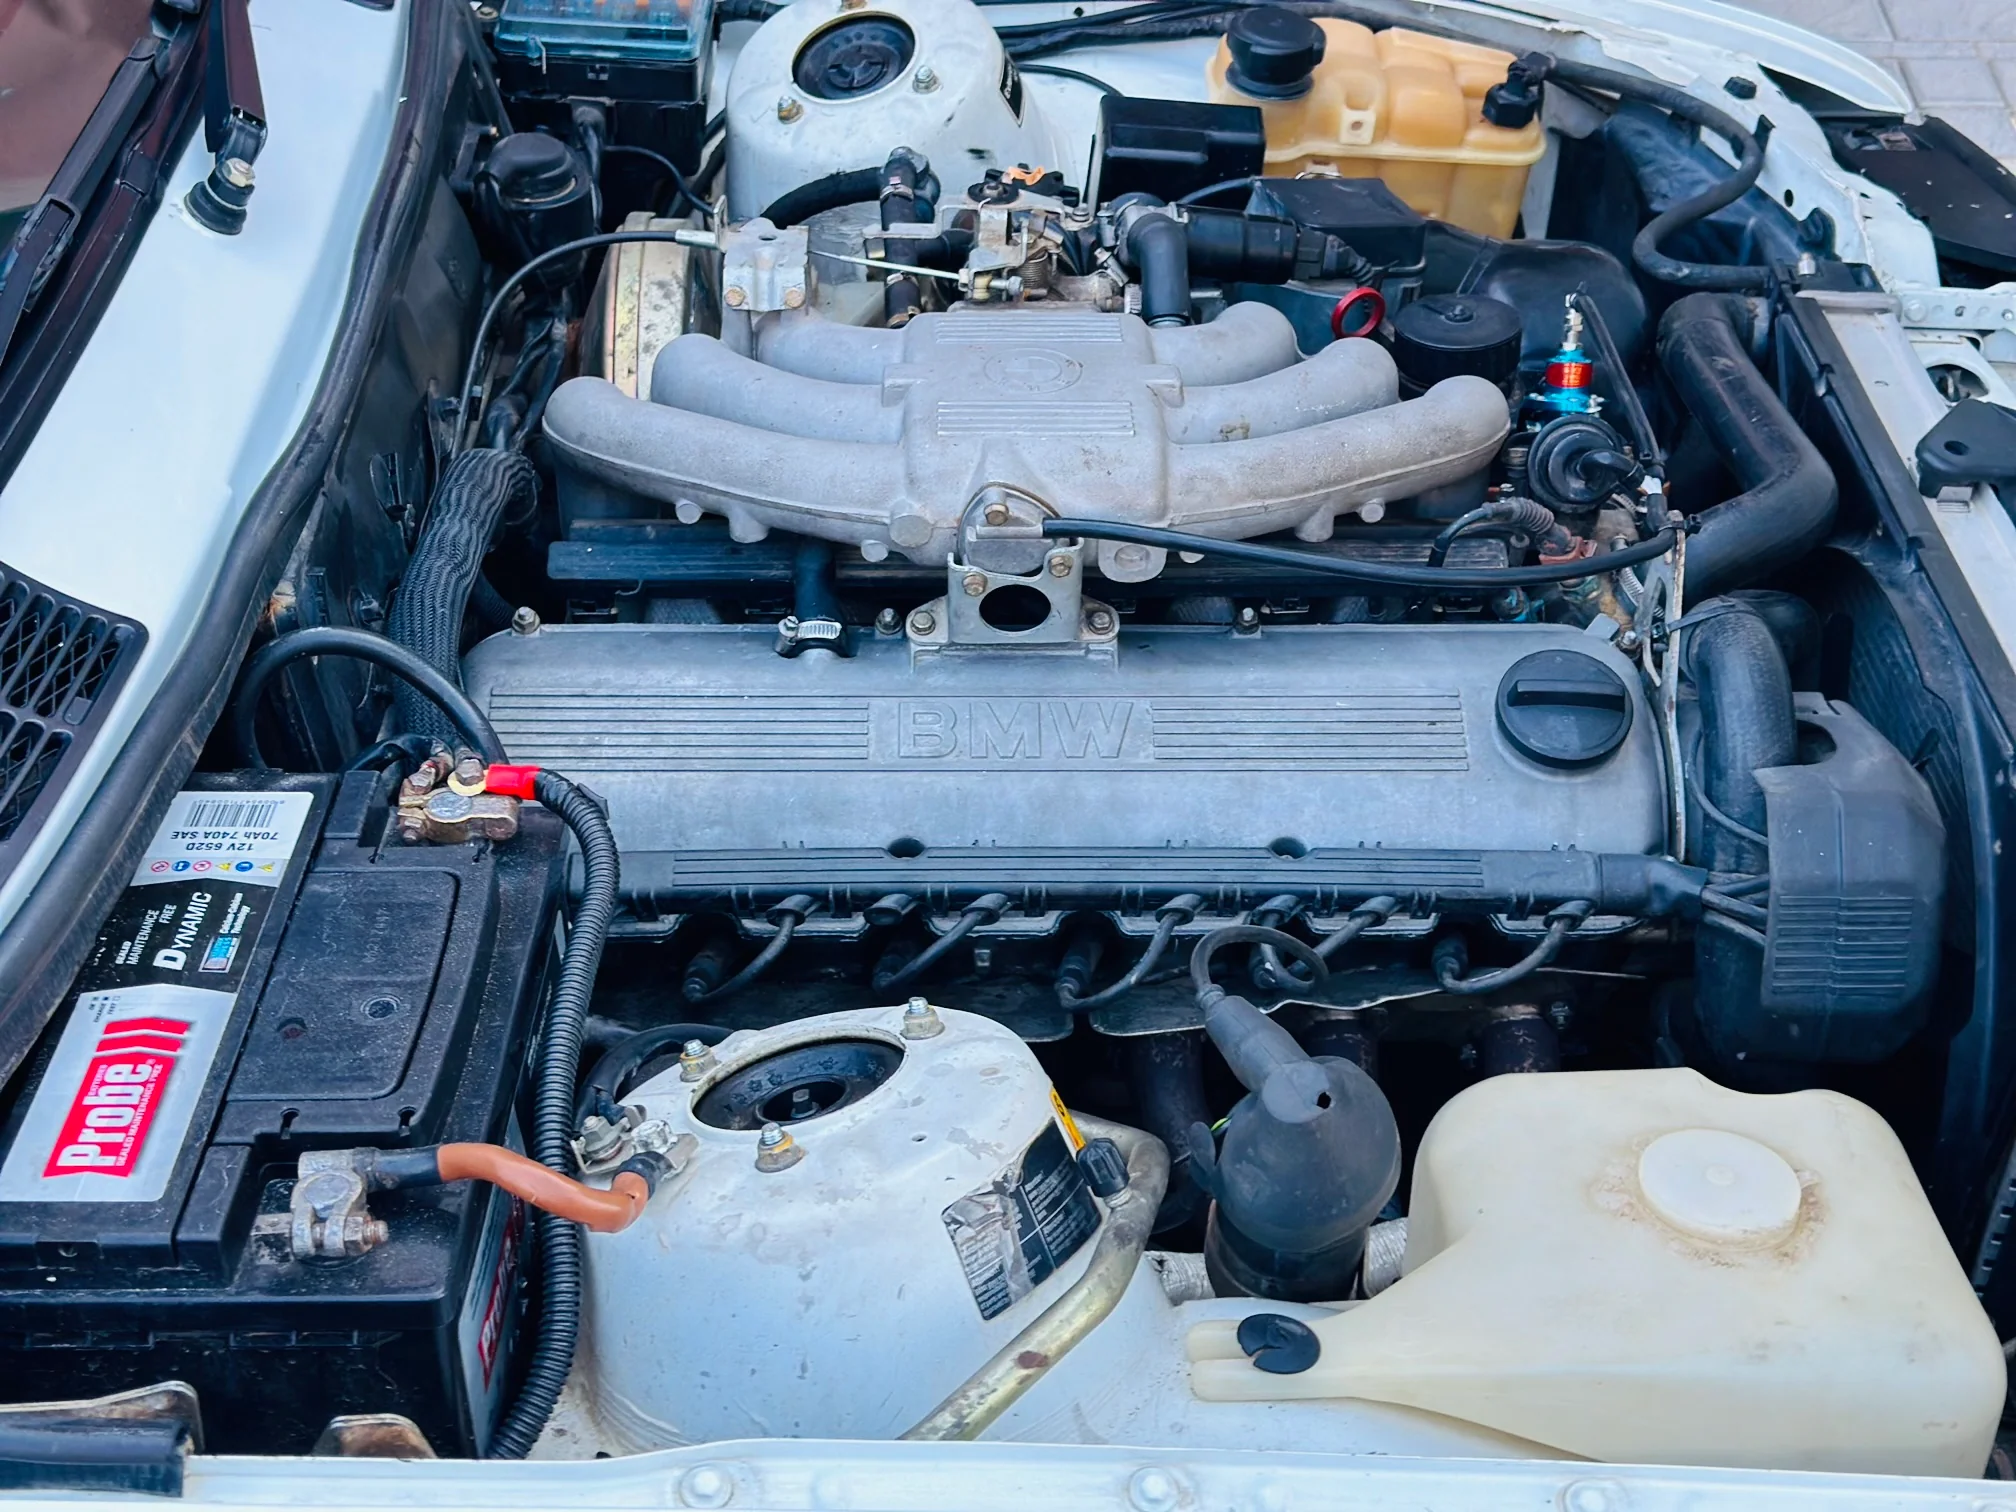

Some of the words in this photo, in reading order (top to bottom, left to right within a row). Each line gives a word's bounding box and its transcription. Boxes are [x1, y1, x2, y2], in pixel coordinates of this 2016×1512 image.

[898, 701, 1134, 759] BMW
[170, 831, 199, 840] SAE
[203, 831, 238, 840] 740A
[243, 831, 279, 840] 70Ah
[186, 842, 223, 851] 652D
[226, 842, 254, 851] 12V
[159, 904, 177, 924] FREE
[125, 909, 160, 965] MAINTENANCE
[152, 891, 213, 971] DYNAMIC
[56, 1063, 153, 1167] Probe
[129, 1082, 155, 1137] MAINTENANCE
